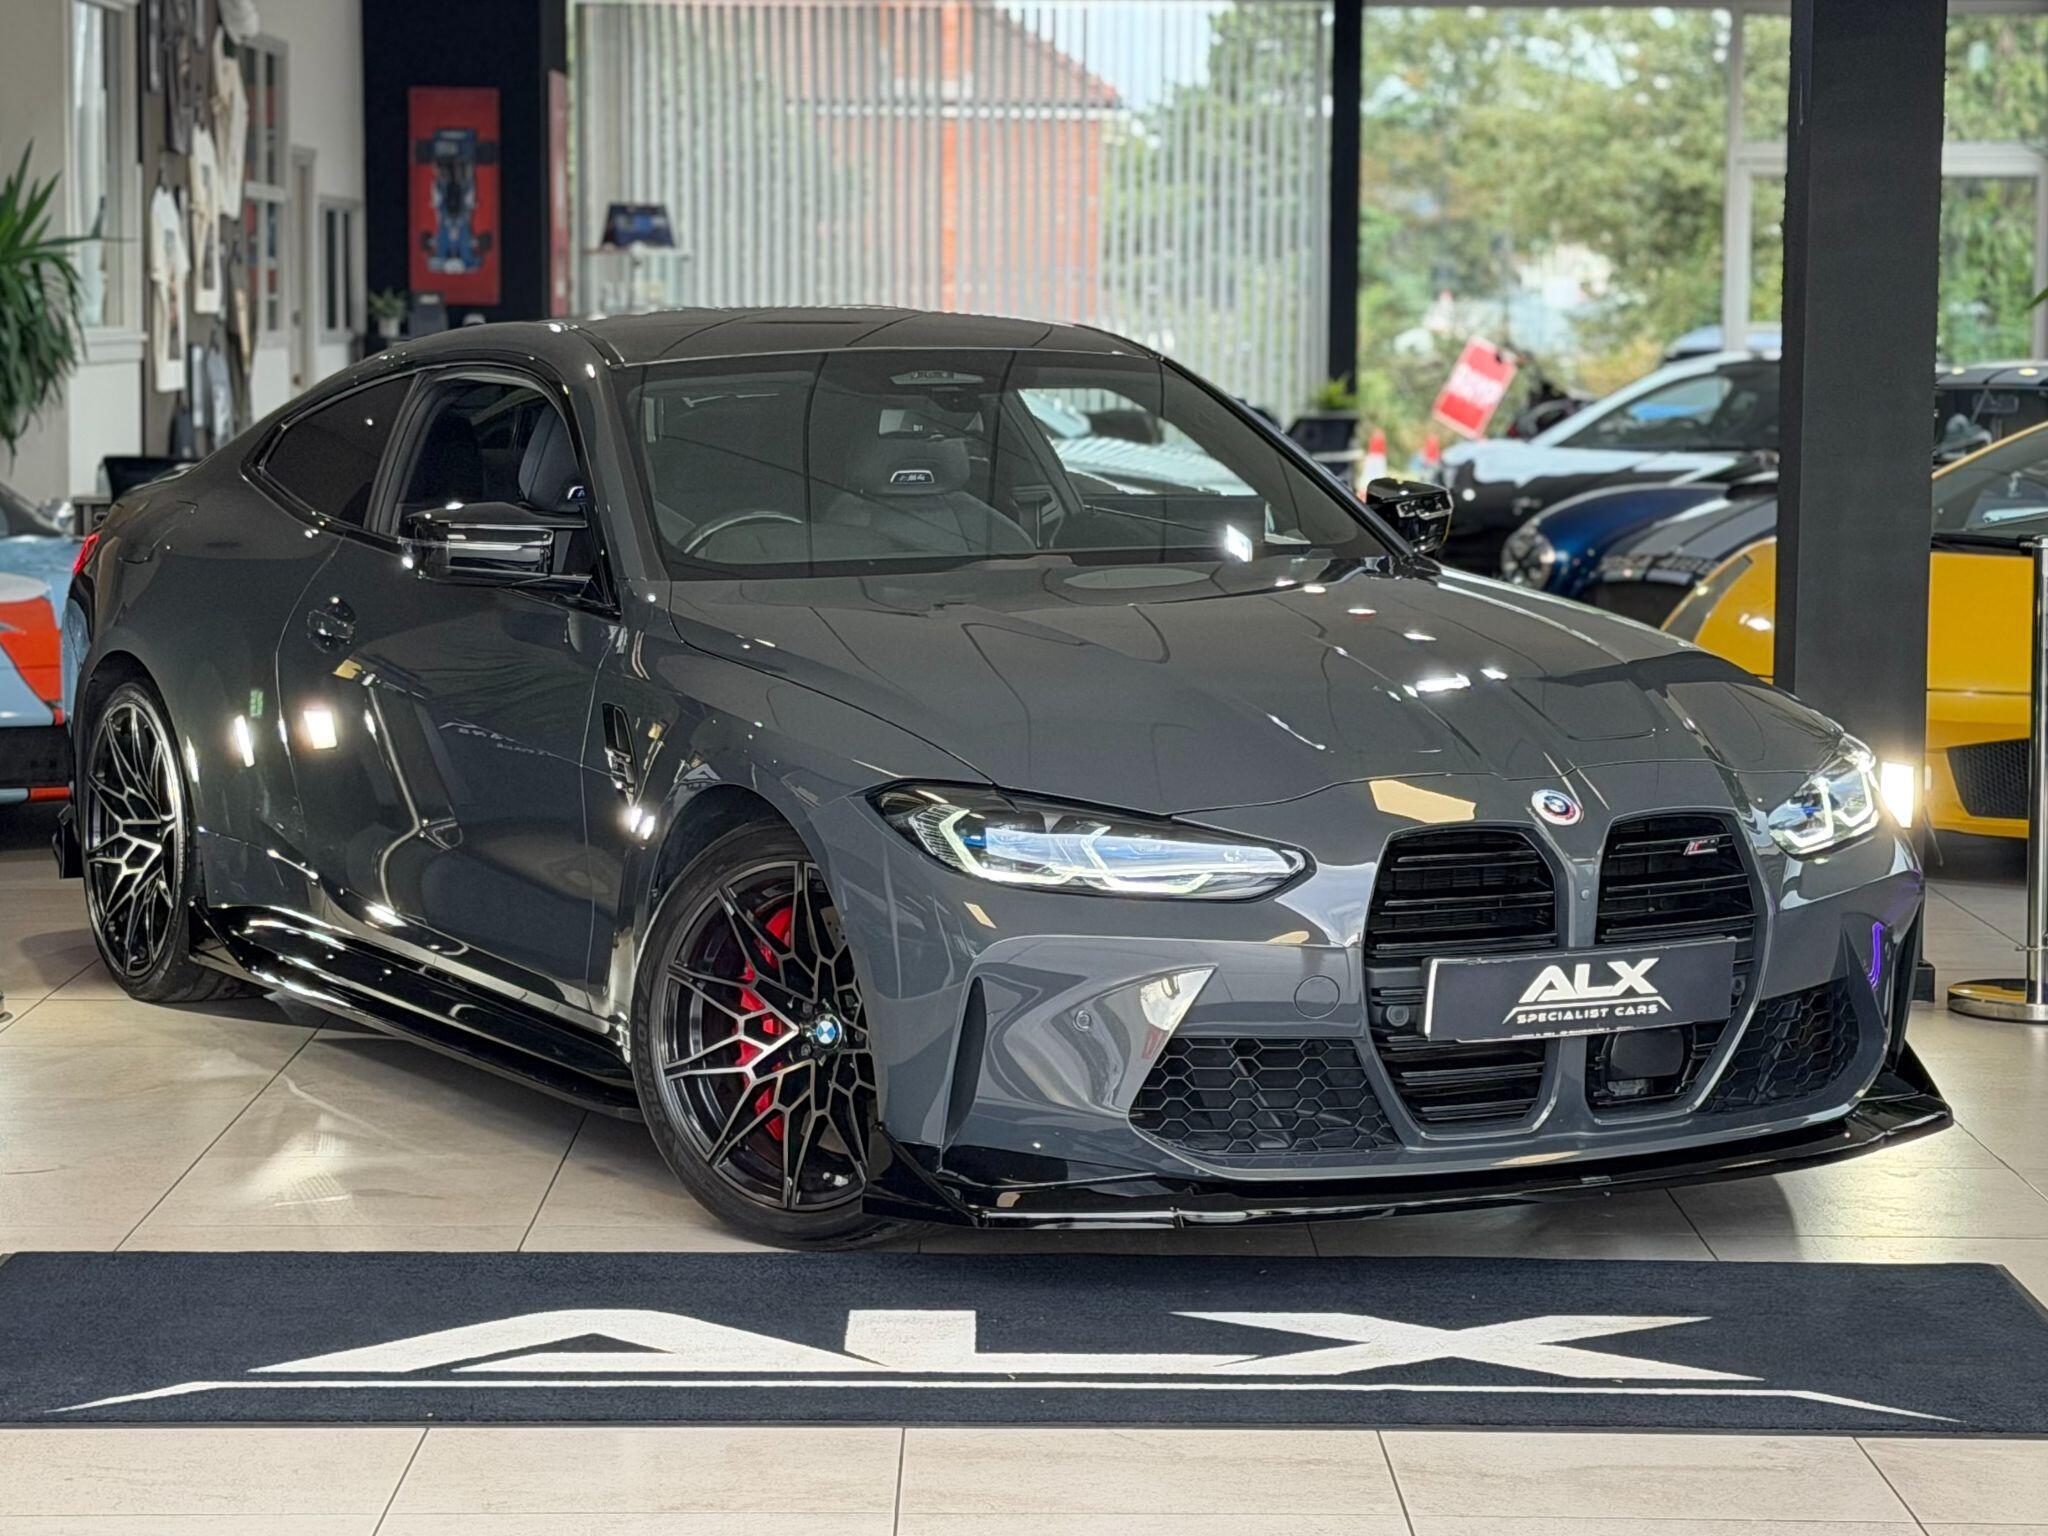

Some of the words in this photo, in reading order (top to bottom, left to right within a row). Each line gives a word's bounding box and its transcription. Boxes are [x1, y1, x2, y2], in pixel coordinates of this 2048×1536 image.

[1517, 957, 1660, 1004] ALX
[1516, 1007, 1610, 1025] SPECIALIST
[1614, 1003, 1659, 1017] CARS
[247, 1307, 1765, 1382] ALX
